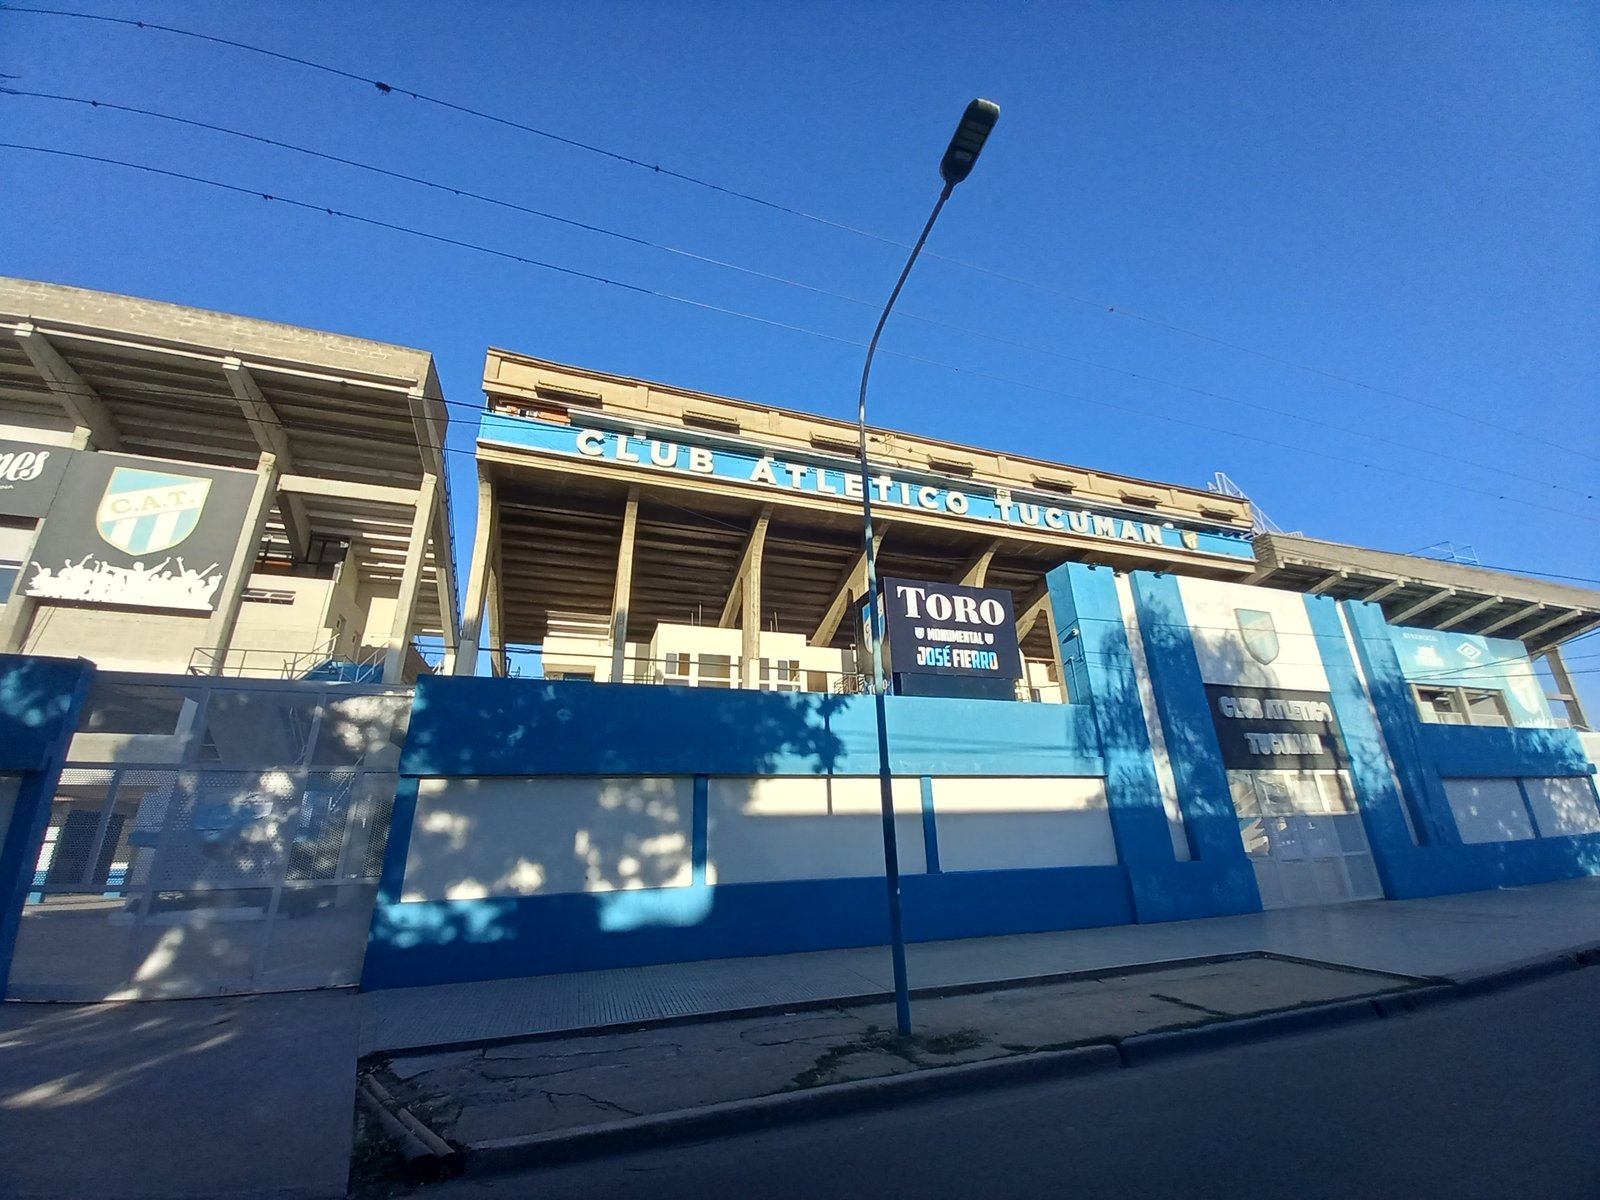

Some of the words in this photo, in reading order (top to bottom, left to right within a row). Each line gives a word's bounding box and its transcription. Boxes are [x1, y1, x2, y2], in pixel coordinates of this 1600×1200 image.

[576, 429, 714, 474] CLUB
[750, 457, 969, 515] ATLETICO
[995, 497, 1163, 546] TUCUMAN
[896, 586, 1006, 626] TORO
[927, 628, 985, 645] MONUMENTAL
[917, 645, 952, 667] JOSÉ
[952, 649, 999, 670] FIERRO
[1218, 696, 1264, 719] CLUB
[1264, 699, 1333, 722] ATLETICO
[1244, 733, 1325, 755] TUCUMAN
